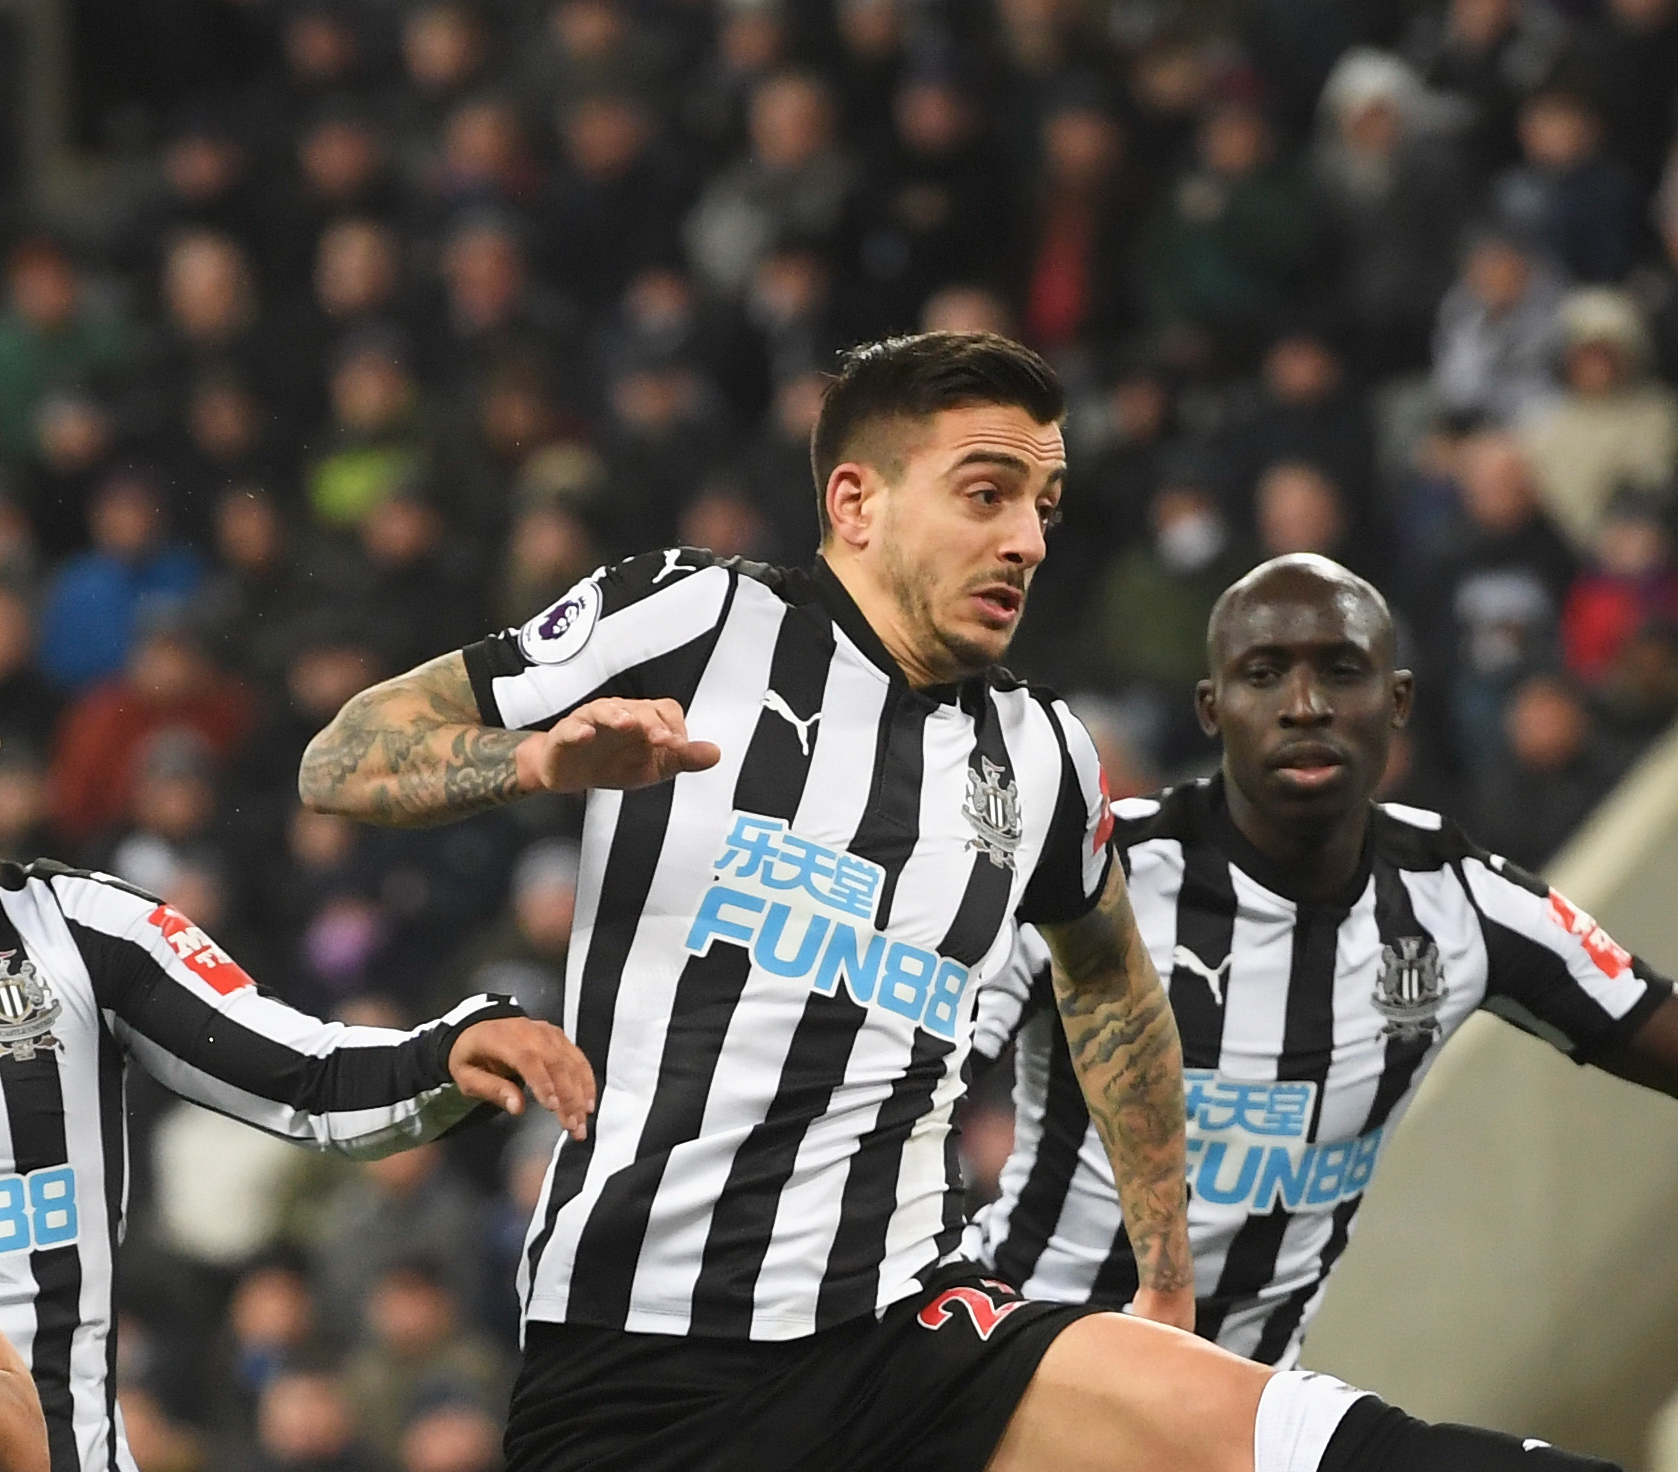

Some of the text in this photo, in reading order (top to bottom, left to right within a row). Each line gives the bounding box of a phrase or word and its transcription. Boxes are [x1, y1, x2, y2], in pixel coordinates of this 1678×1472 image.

[714, 816, 879, 919] 乐天堂
[685, 885, 969, 1038] FUN88
[1187, 1127, 1383, 1208] UN88
